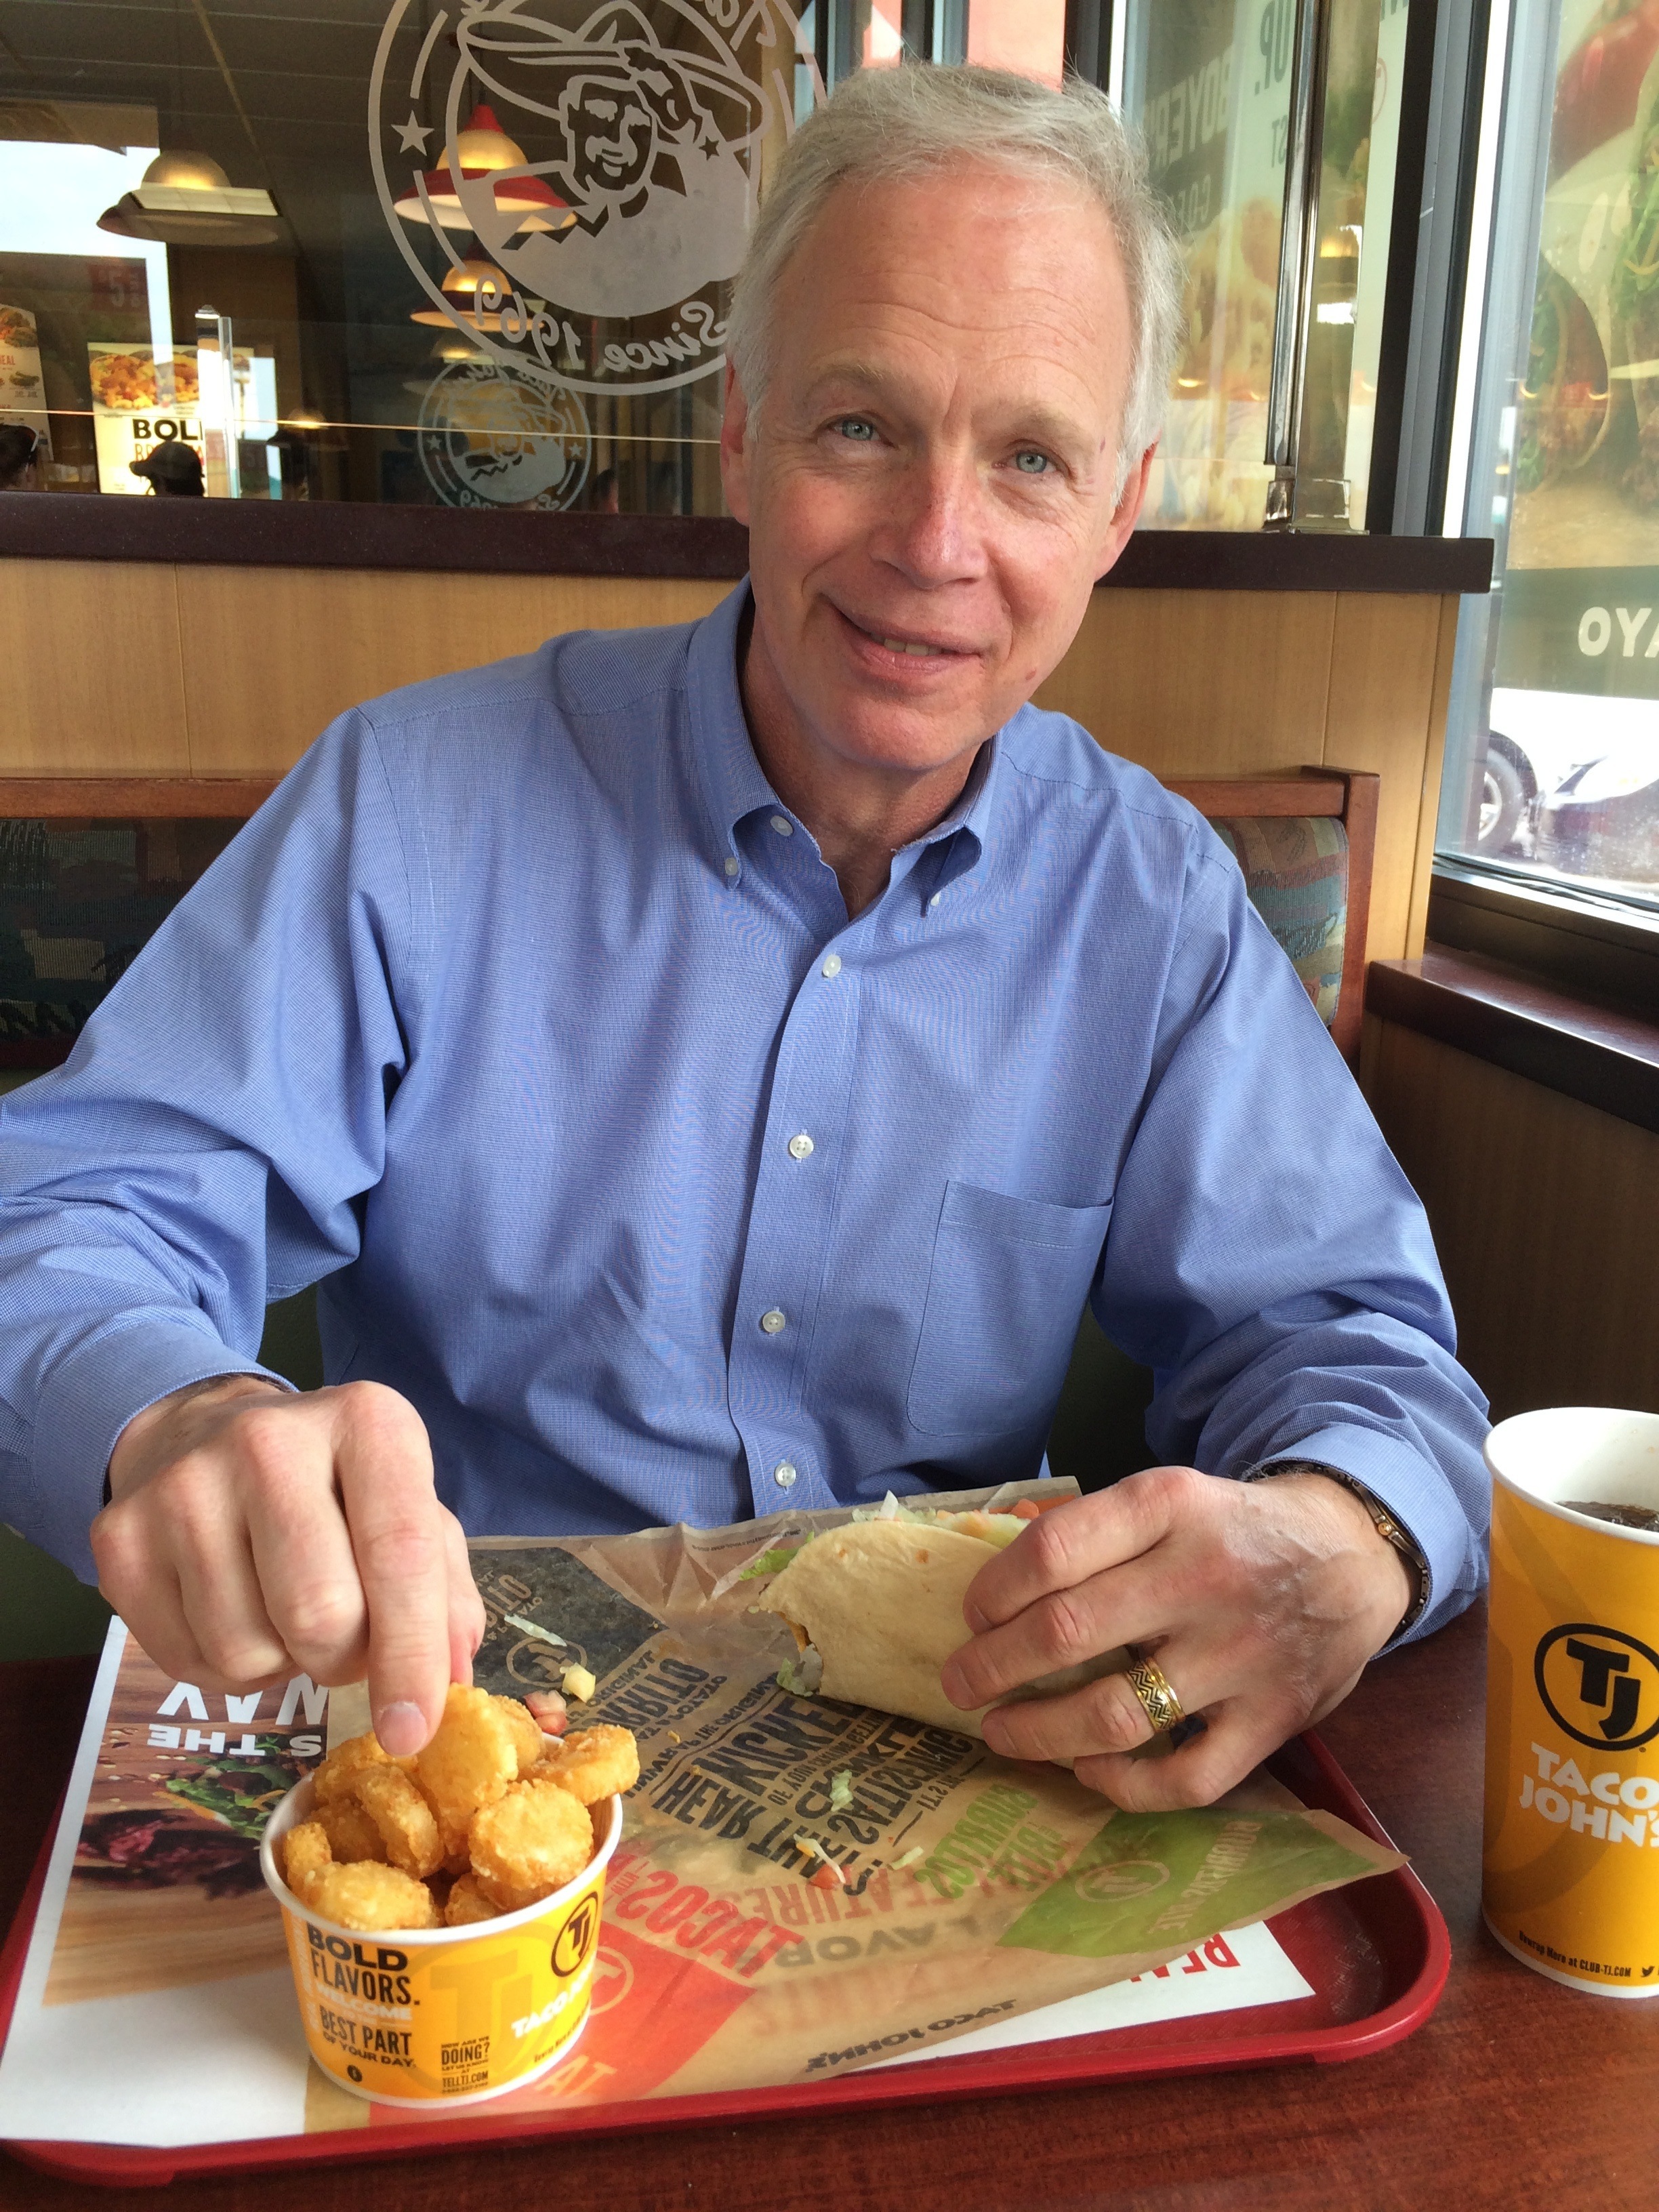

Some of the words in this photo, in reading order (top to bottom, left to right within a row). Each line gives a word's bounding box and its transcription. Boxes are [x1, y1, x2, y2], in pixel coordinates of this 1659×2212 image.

[132, 418, 203, 442] BOL
[1565, 1637, 1641, 1740] TJ
[146, 1723, 266, 1757] THE
[1531, 1741, 1659, 1810] TACO
[306, 1921, 409, 1972] BOLD
[1568, 1957, 1578, 1968] at
[310, 1947, 421, 2006] FLAVORS.
[319, 2004, 357, 2045] BEST
[363, 2024, 413, 2056] PART
[511, 1990, 569, 2039] TACO
[340, 2040, 379, 2063] YOUR
[441, 2042, 490, 2065] DOING?
